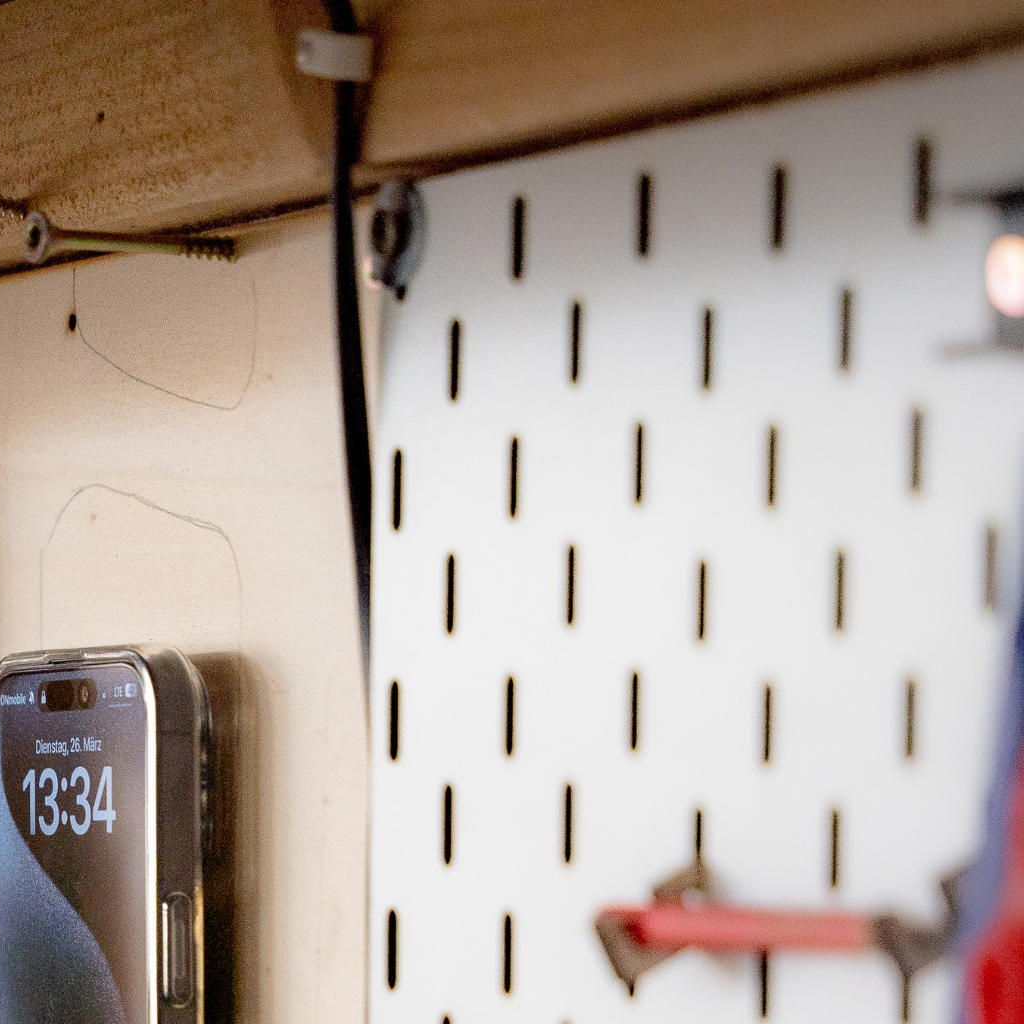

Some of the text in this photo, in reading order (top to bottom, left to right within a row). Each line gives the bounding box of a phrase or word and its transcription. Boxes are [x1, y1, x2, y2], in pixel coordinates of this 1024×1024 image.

[114, 686, 123, 698] LTE
[35, 737, 102, 756] Dienstag, 26. März
[22, 766, 117, 836] 13:34
